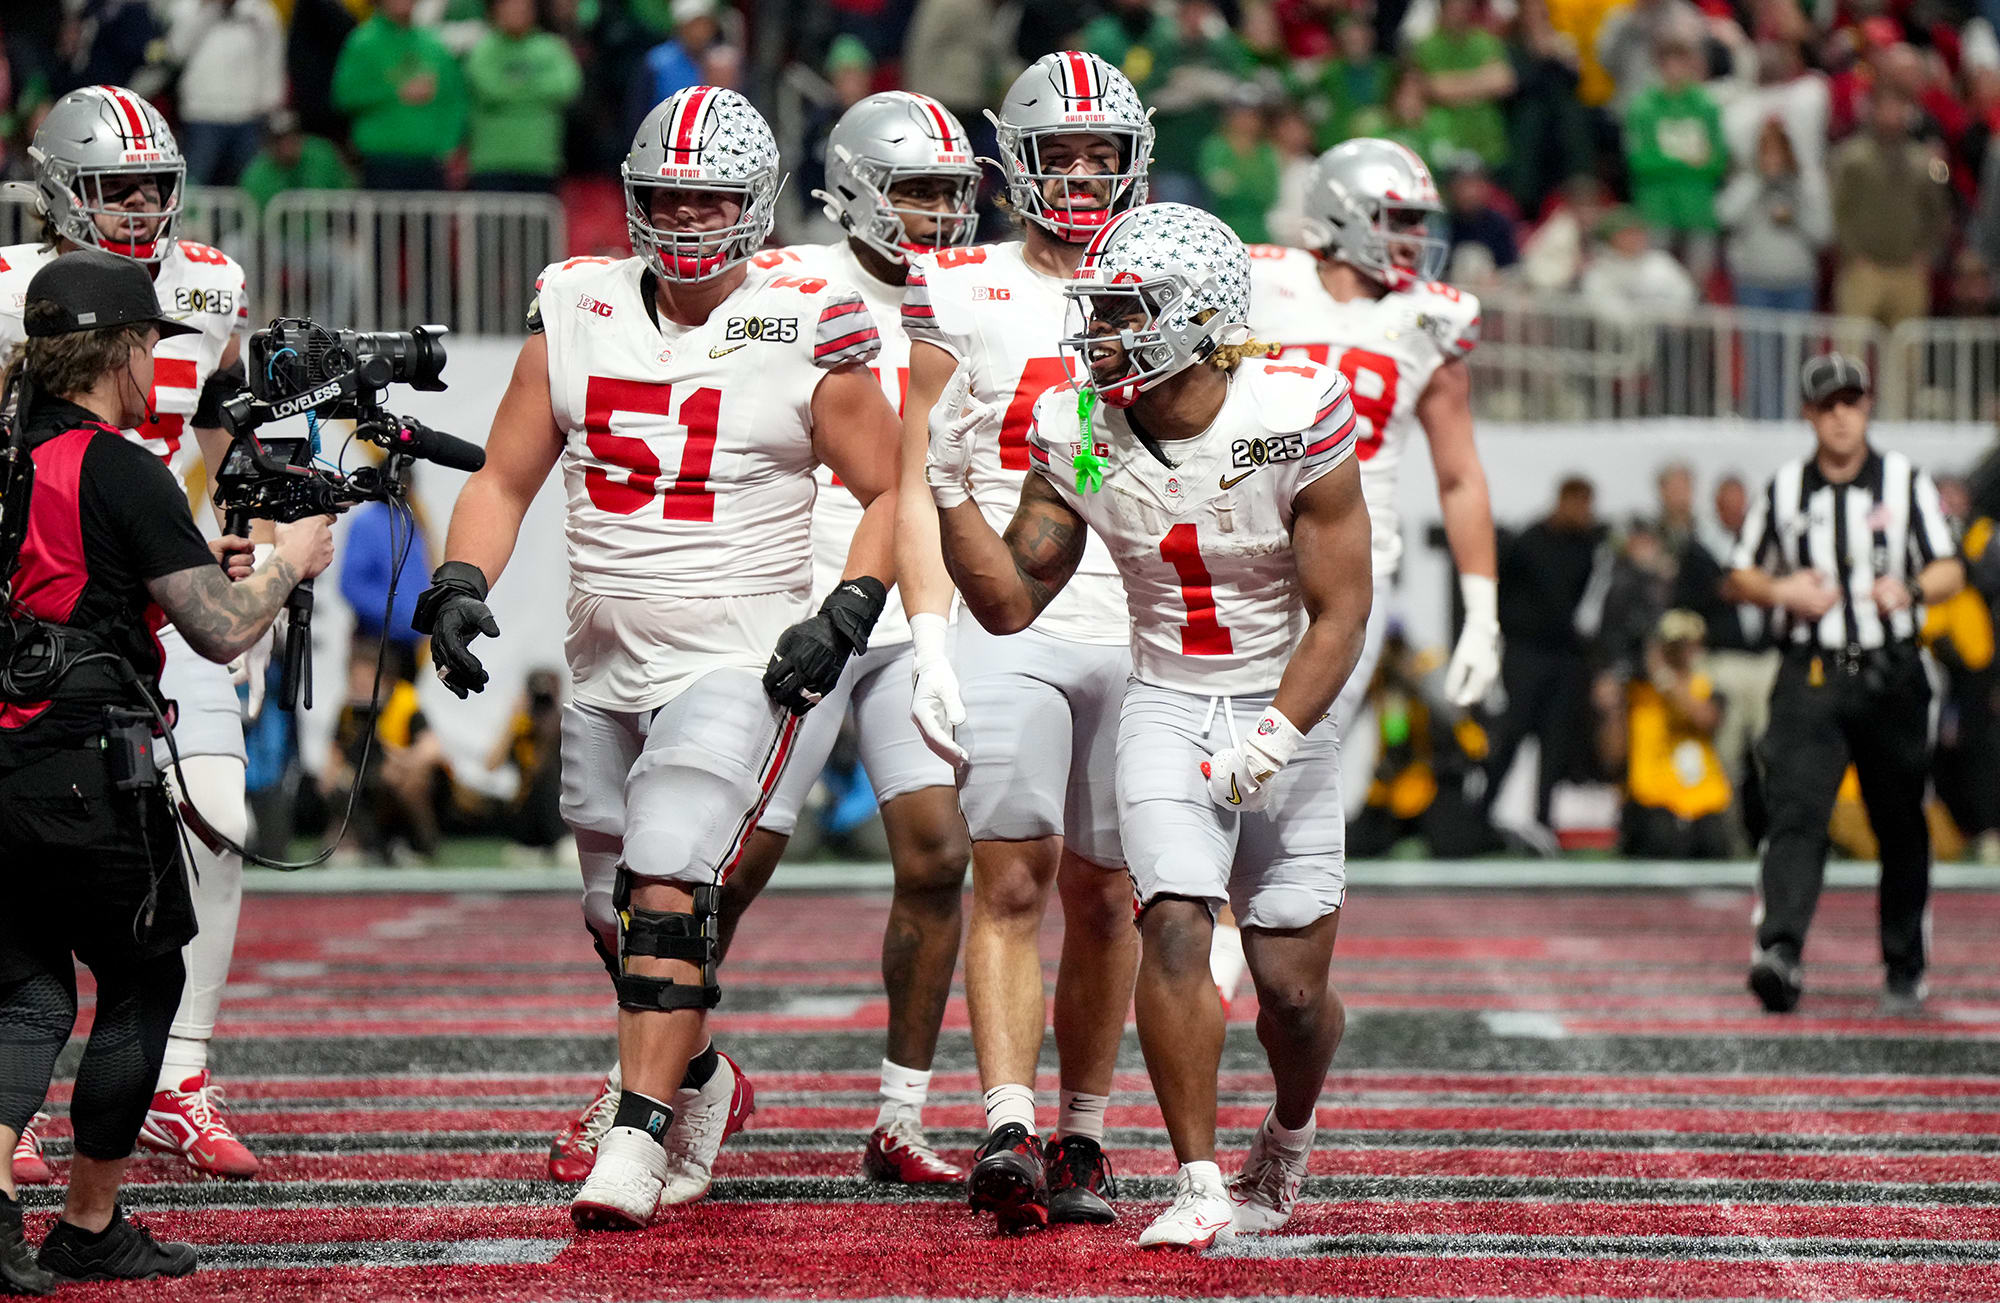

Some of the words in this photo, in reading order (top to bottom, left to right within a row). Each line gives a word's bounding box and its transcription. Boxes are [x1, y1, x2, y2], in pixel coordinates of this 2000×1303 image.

[1085, 113, 1105, 121] STATE
[661, 168, 678, 177] OHIO
[679, 168, 700, 178] STATE
[175, 287, 233, 315] 2025
[577, 293, 613, 318] BIG
[972, 286, 1010, 301] BIG
[726, 316, 799, 343] 2025
[271, 381, 342, 419] LOVELESS
[584, 375, 722, 523] 51
[1070, 441, 1109, 458] BG
[1231, 433, 1306, 468] 2025
[1159, 523, 1234, 655] 1
